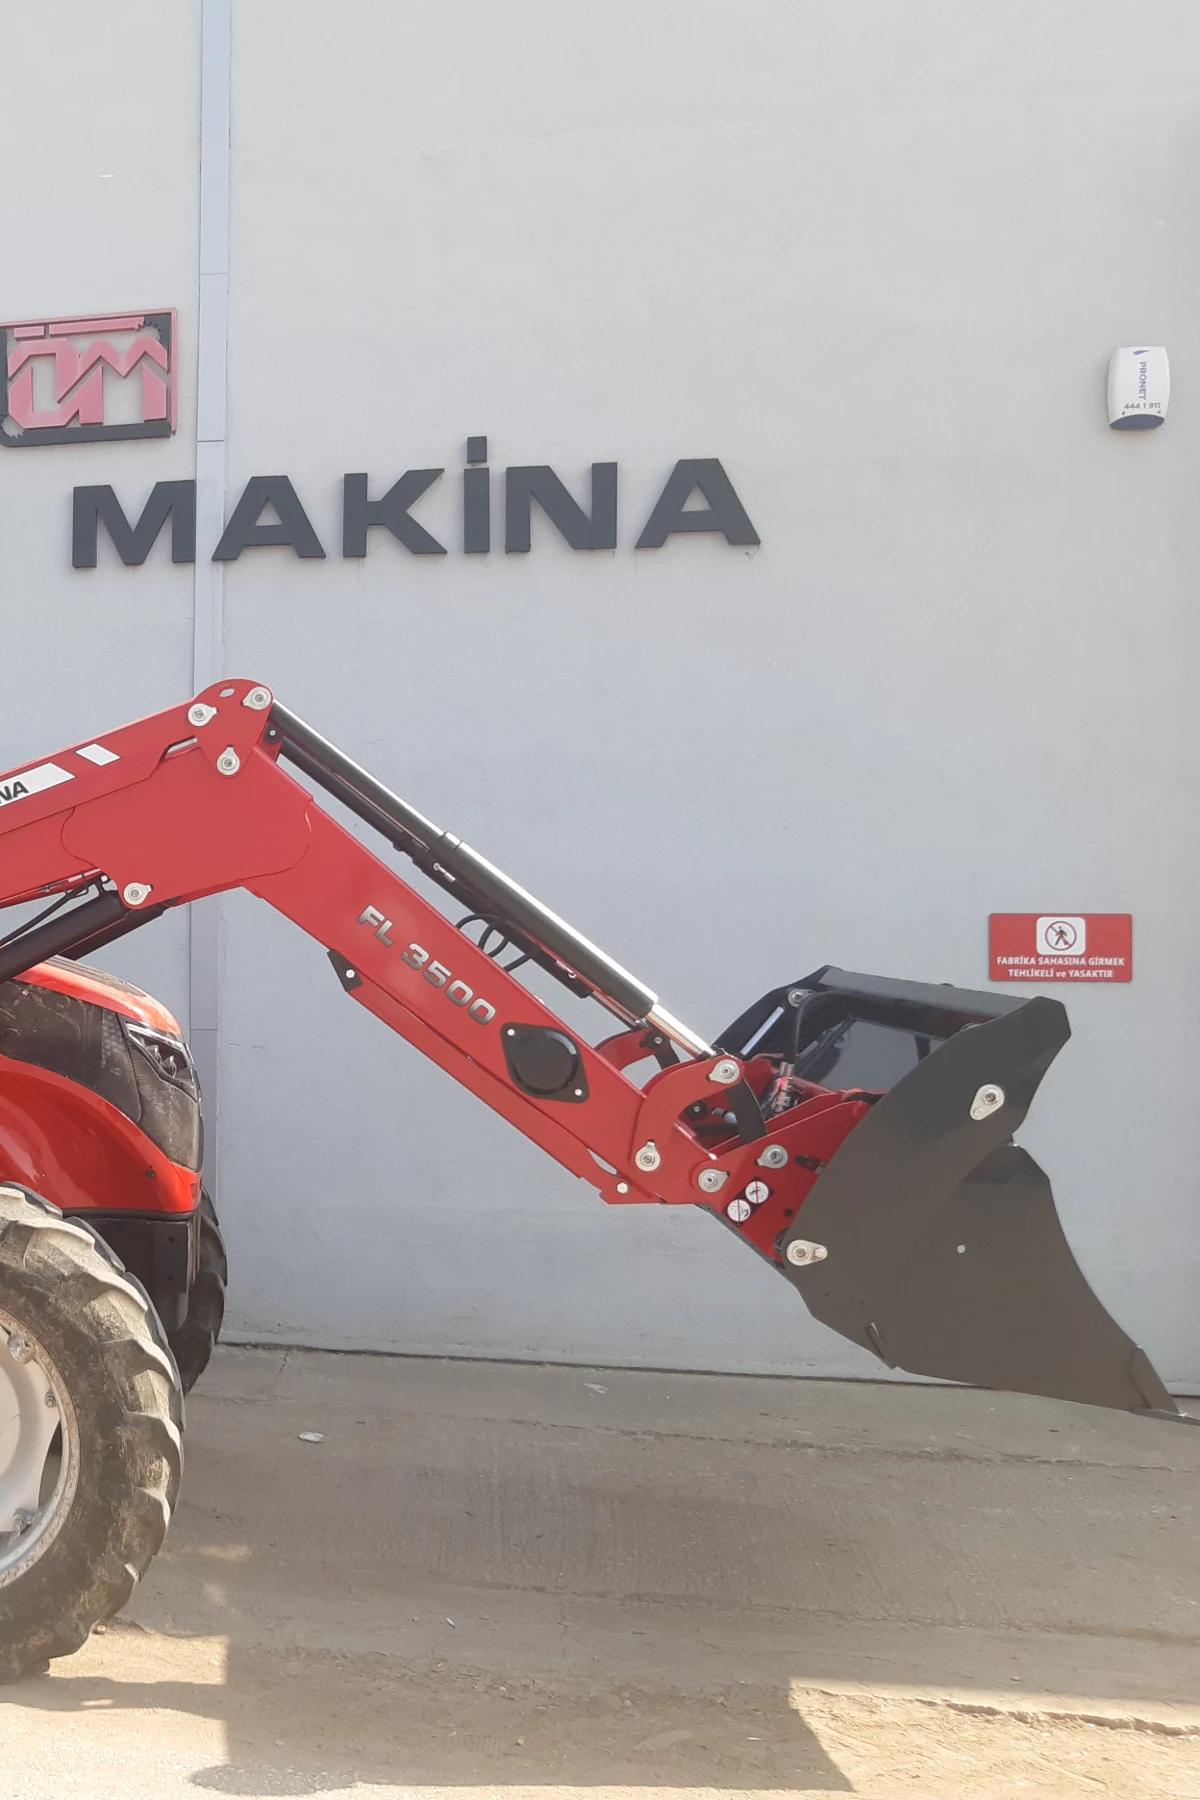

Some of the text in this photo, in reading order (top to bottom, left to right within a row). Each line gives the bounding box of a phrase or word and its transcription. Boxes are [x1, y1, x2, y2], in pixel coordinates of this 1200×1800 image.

[1138, 361, 1147, 400] PRONET
[72, 436, 761, 569] MAKİNA
[356, 905, 497, 1026] FL 3500
[997, 955, 1125, 966] FABRİKA SAHASINA GİRMEK
[1008, 967, 1054, 977] TEHLİKELİ
[1068, 969, 1113, 978] YASAKTIR
